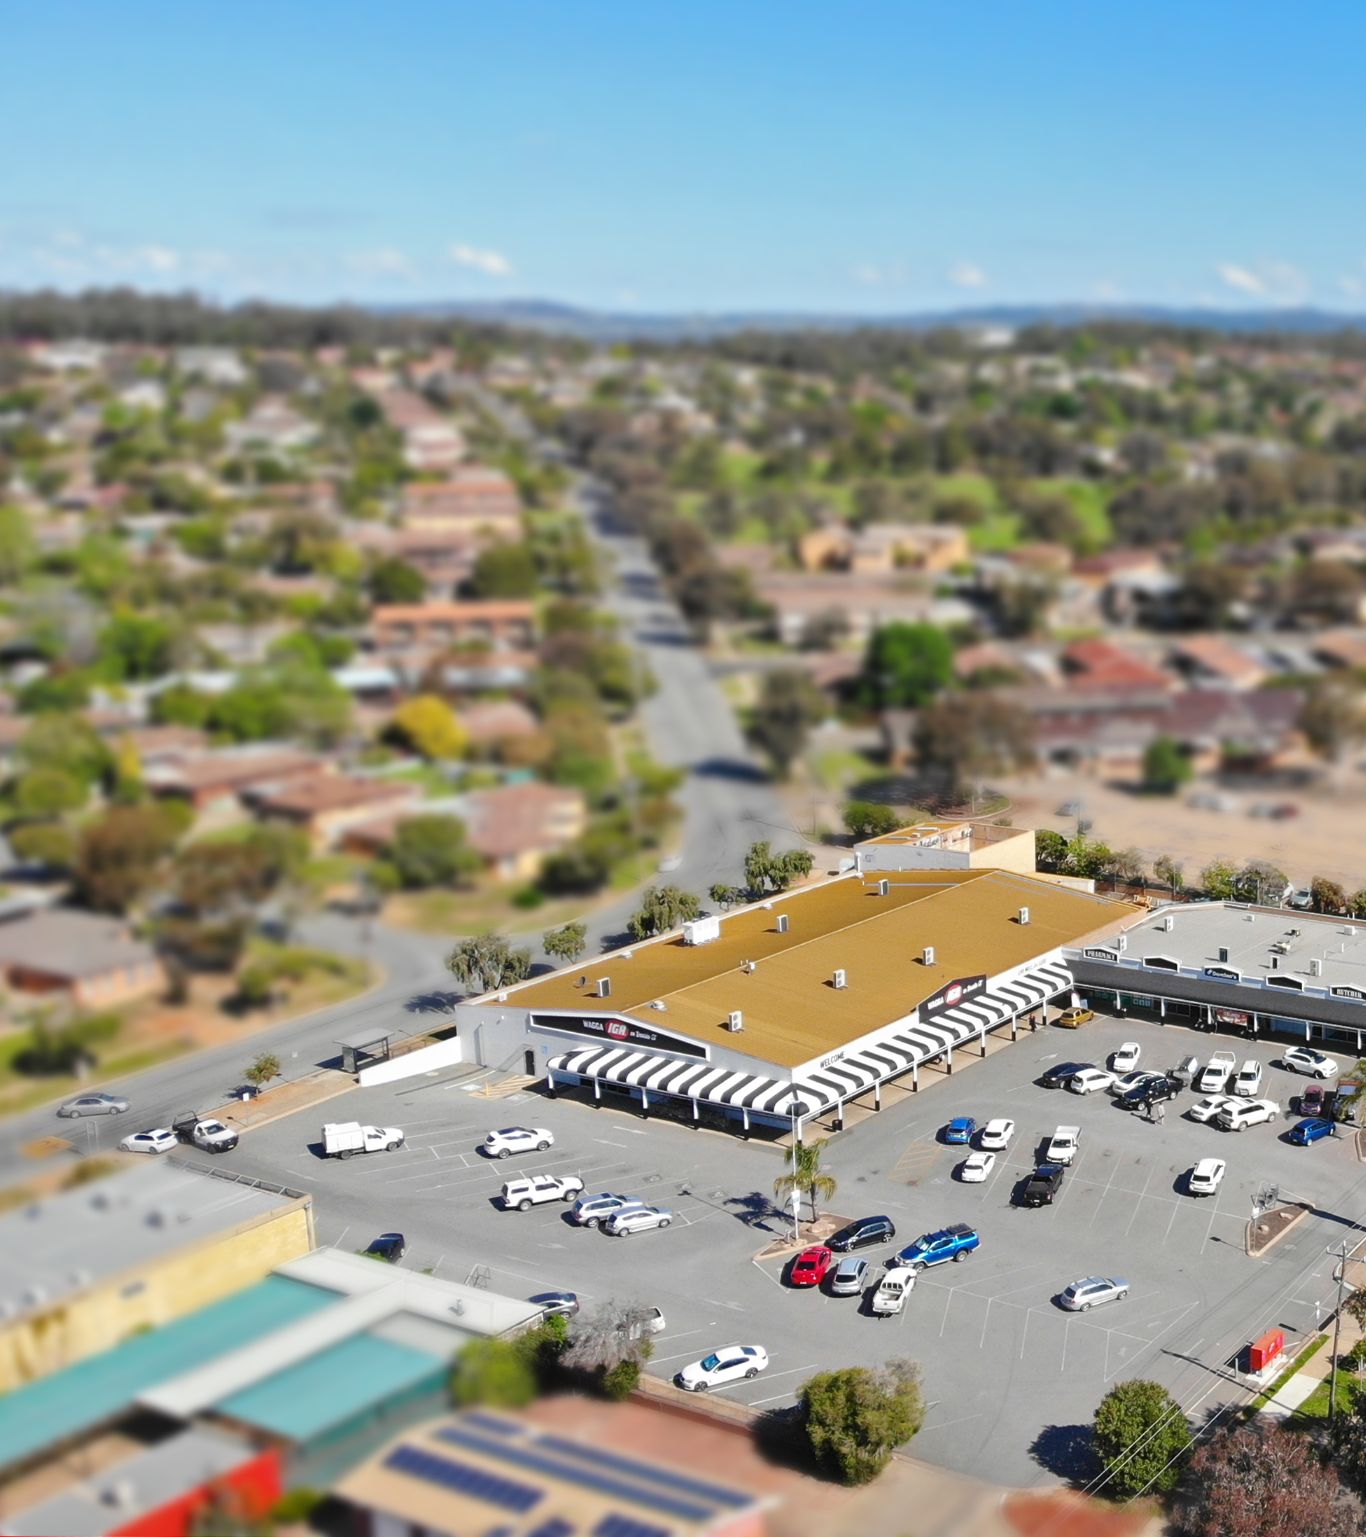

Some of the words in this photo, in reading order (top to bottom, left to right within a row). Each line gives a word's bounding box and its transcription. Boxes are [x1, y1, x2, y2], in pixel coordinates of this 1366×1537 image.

[582, 1020, 604, 1031] WAGGA
[607, 1022, 627, 1036] IGA
[820, 1051, 845, 1068] WELCOME
